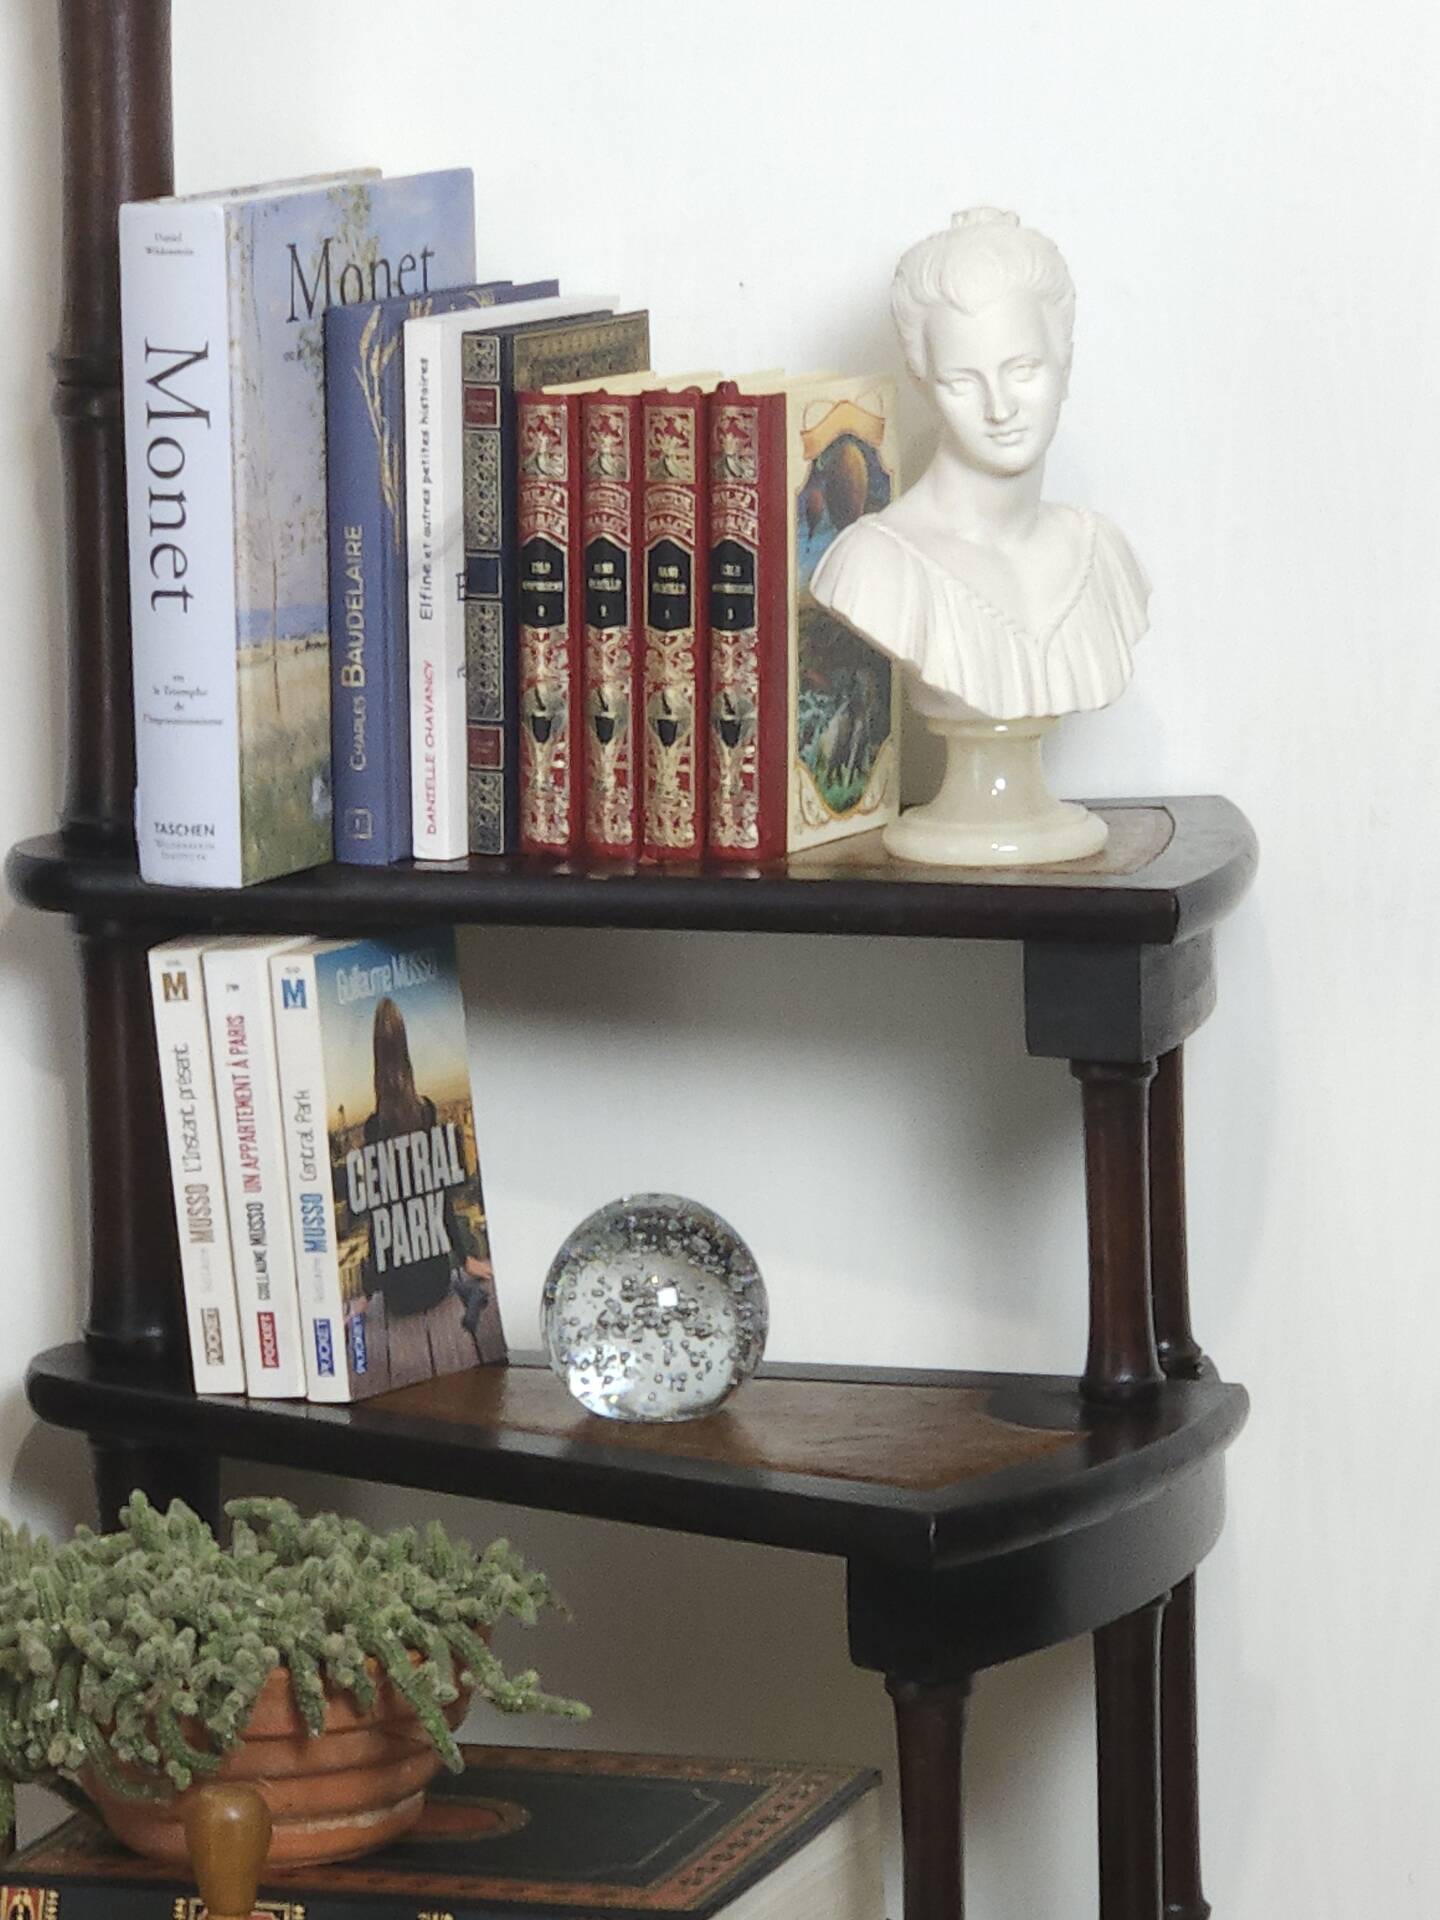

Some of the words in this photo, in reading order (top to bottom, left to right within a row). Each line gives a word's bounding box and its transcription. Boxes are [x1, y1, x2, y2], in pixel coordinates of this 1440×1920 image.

[286, 236, 435, 323] Monet
[419, 357, 430, 425] histoires
[145, 337, 211, 613] Monet
[420, 430, 433, 484] petites
[421, 488, 433, 537] autres
[421, 544, 432, 559] et
[341, 524, 365, 688] BAUDELAIRE
[419, 564, 433, 621] Elfine
[423, 660, 436, 748] CHAVANCY
[350, 695, 367, 771] CHARLES
[424, 752, 437, 835] DANIELLE
[153, 821, 216, 837] TASCHEN
[161, 971, 189, 1002] M
[281, 978, 308, 1010] M
[226, 1014, 248, 1057] PARIS
[227, 1057, 250, 1069] À
[231, 1073, 261, 1171] APPARTEMENT
[294, 1089, 313, 1124] Park
[242, 1173, 263, 1194] UN
[298, 1129, 318, 1182] Central
[346, 1122, 466, 1216] CENTRAL
[184, 1183, 215, 1243] MUSSO
[246, 1202, 268, 1246] MUSSO
[300, 1192, 328, 1254] MUSSO
[371, 1189, 452, 1274] PARK
